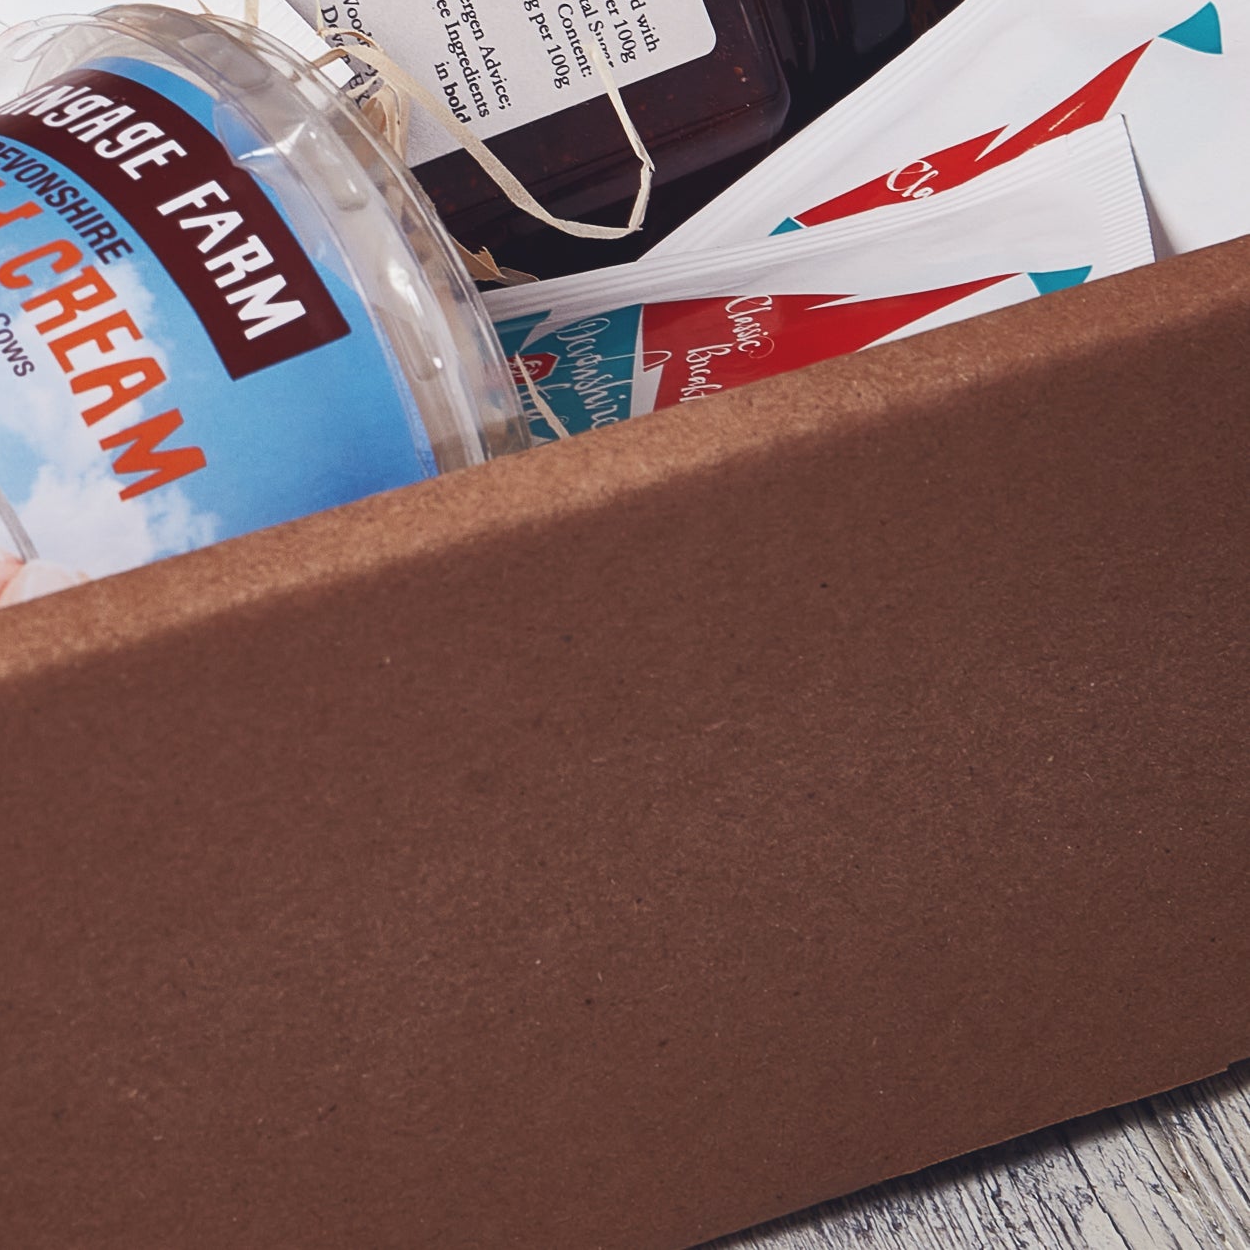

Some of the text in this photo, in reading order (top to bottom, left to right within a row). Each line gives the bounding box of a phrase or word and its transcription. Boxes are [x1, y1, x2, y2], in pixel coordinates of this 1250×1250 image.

[529, 12, 554, 41] per
[546, 44, 571, 89] 100g
[557, 3, 593, 78] Content:
[613, 19, 637, 64] 100g
[636, 14, 660, 53] with
[435, 61, 472, 123] in bold
[444, 21, 491, 118] Ingredients
[479, 45, 512, 111] Advice;
[156, 180, 307, 341] FARM
[724, 294, 775, 359] Classic
